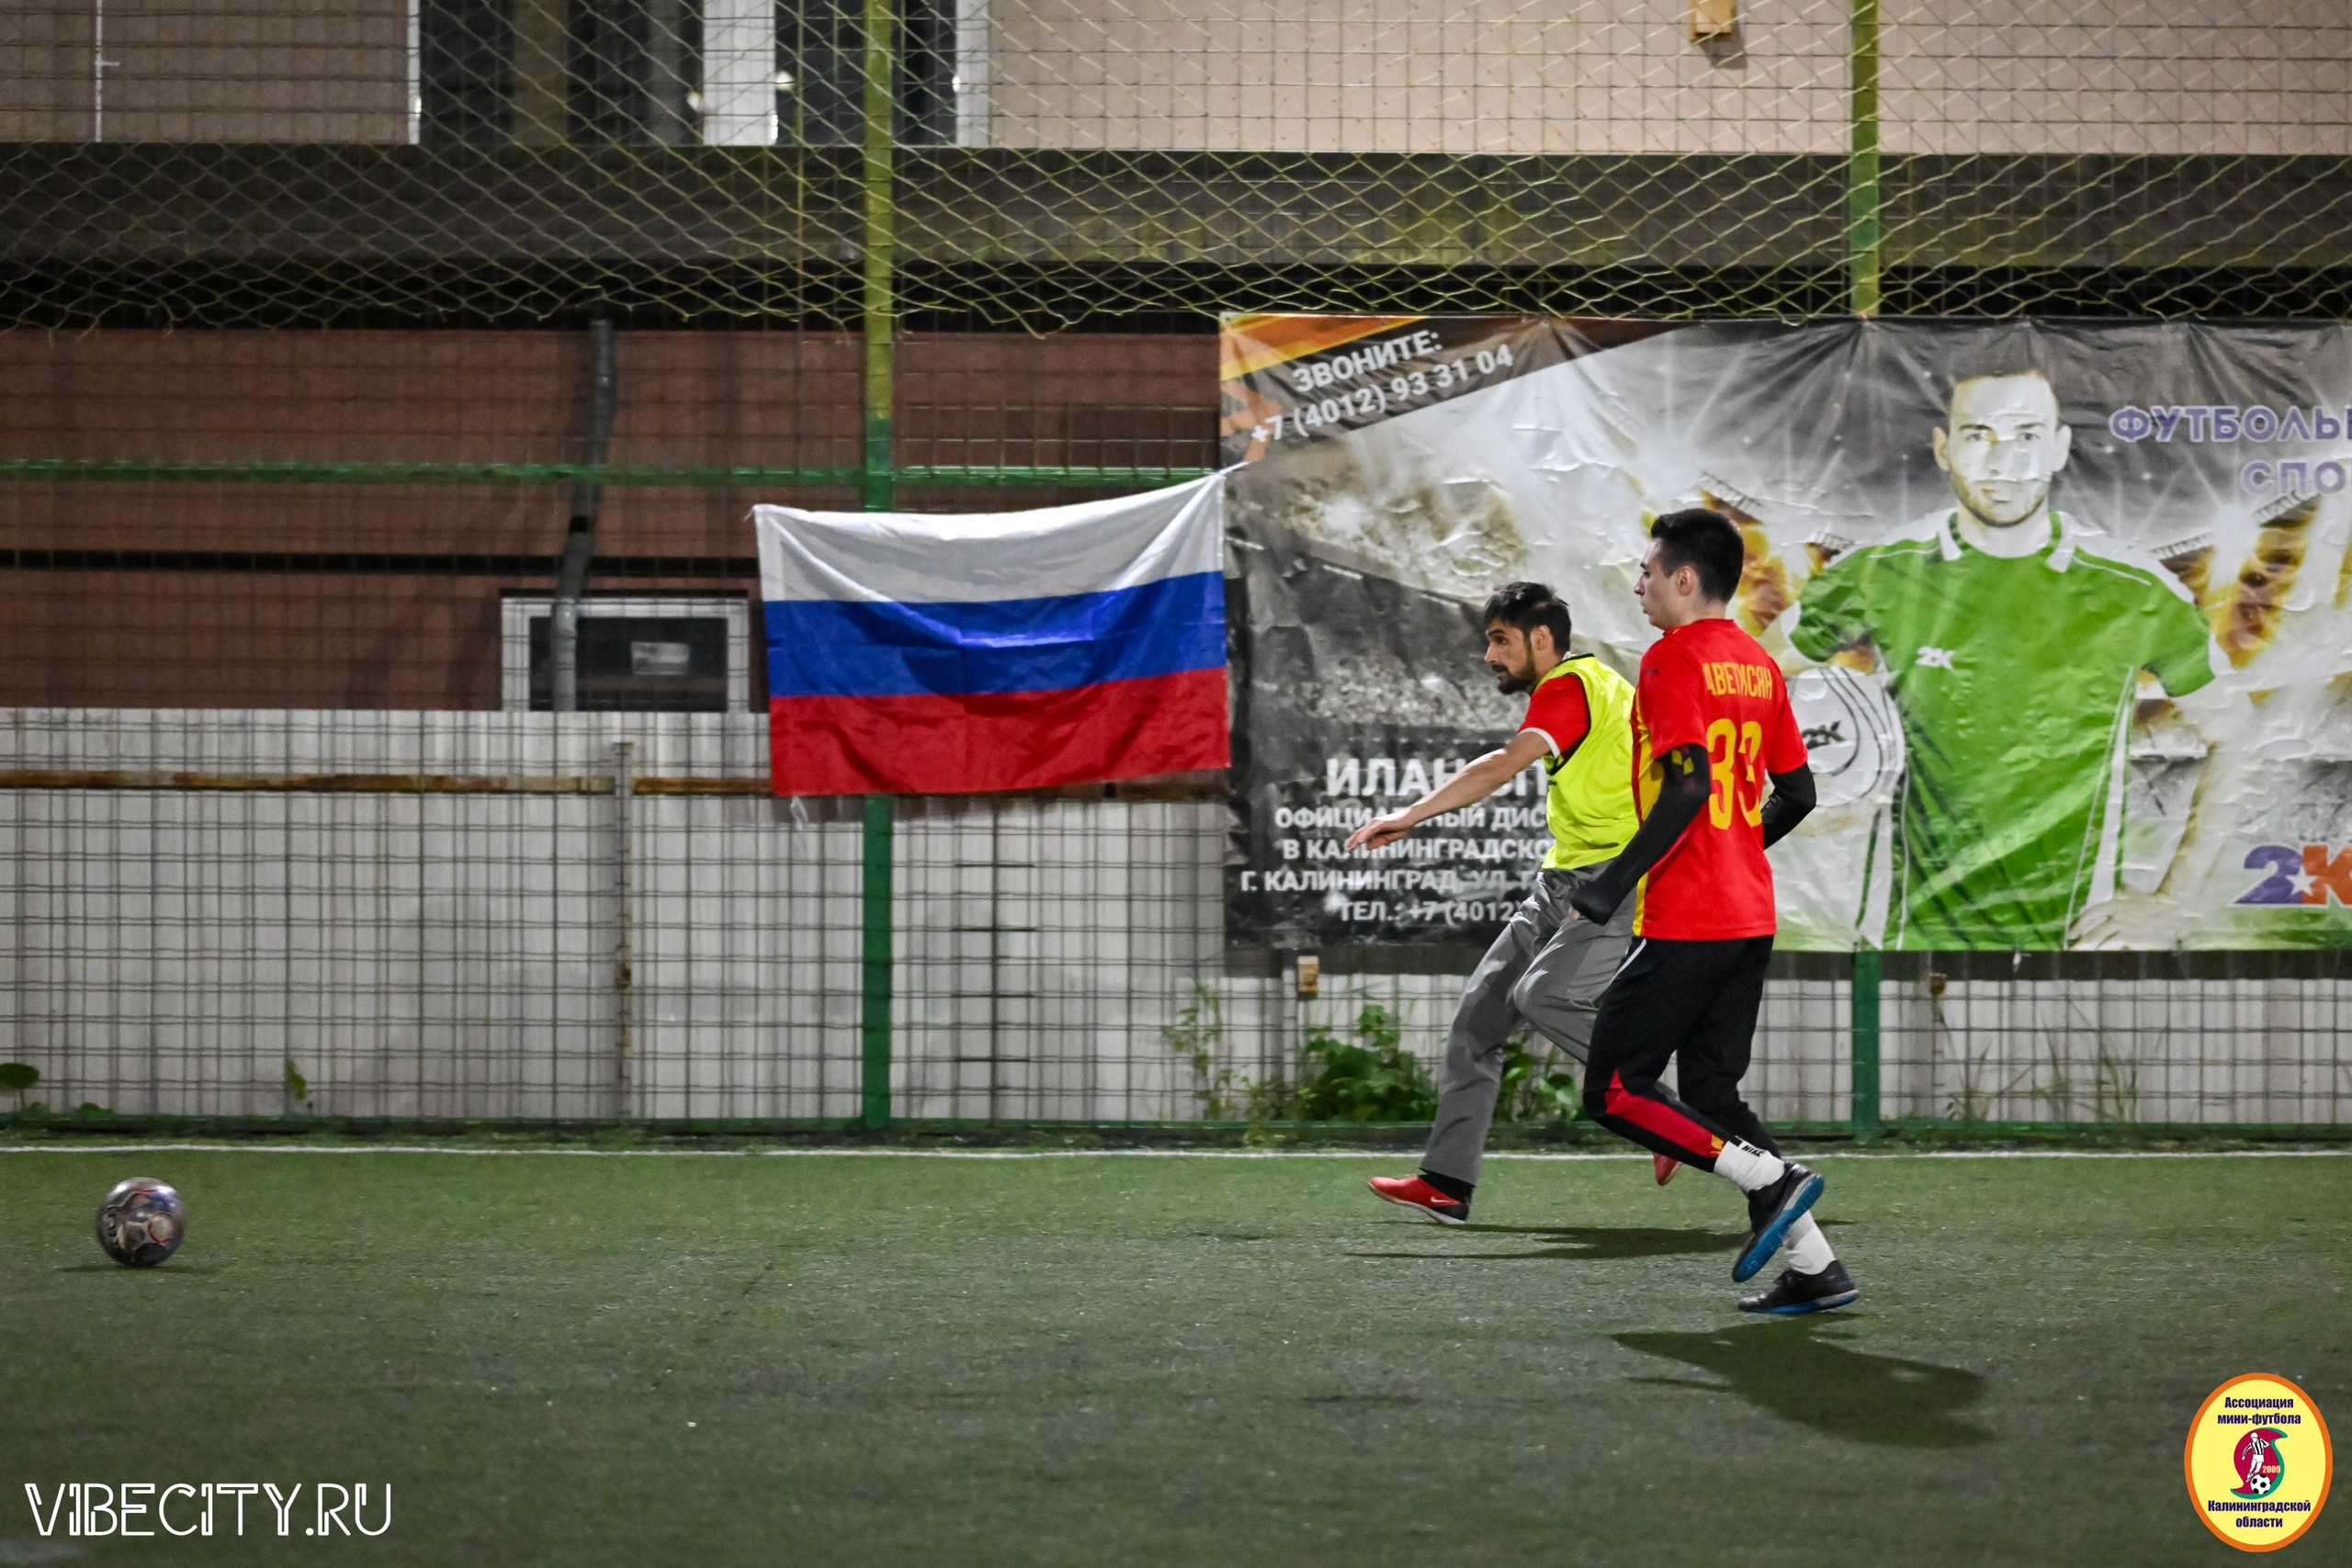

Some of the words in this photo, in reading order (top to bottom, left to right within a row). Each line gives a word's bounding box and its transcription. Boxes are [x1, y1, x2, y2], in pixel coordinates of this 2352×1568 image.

[1293, 330, 1442, 392] ЗВОНИТЕ:
[1250, 415, 1284, 443] +7
[1294, 384, 1387, 437] (4012)
[1395, 371, 1428, 401] 93
[1436, 363, 1469, 388] 31
[1476, 344, 1514, 375] 04
[2240, 460, 2352, 494] СПО
[1706, 718, 1762, 829] 33
[1274, 802, 1486, 831] ОФИЦИАЫЙ
[1283, 839, 1300, 860] В
[1306, 838, 1556, 863] КАИНИНГРАДСКО
[1241, 871, 1258, 891] Г.
[2233, 844, 2352, 905] 2K
[1408, 899, 1438, 920] +7
